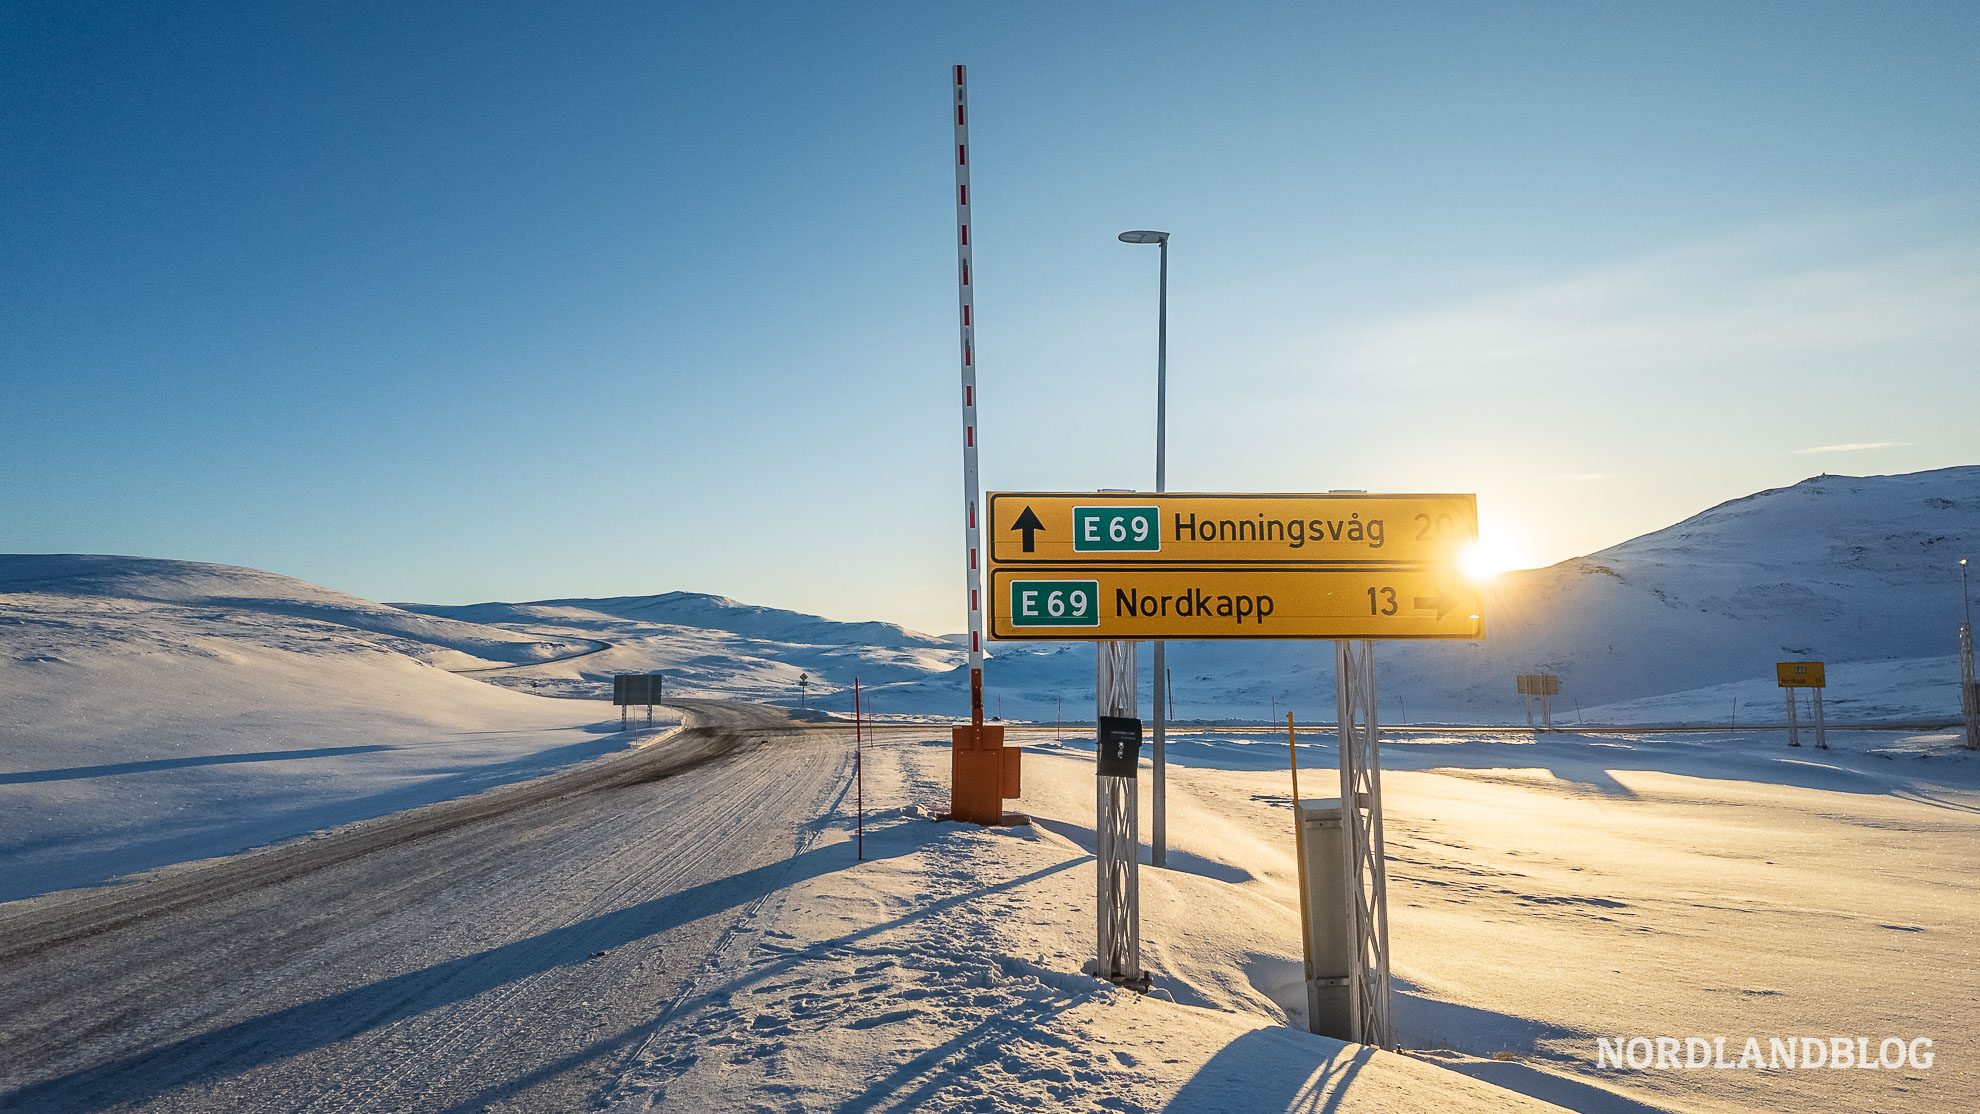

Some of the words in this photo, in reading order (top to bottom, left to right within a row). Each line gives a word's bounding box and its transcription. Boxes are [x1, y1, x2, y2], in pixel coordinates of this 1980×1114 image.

[1175, 512, 1385, 549] Honningsvåg
[1116, 587, 1275, 624] Nordkapp
[1367, 587, 1398, 616] 13
